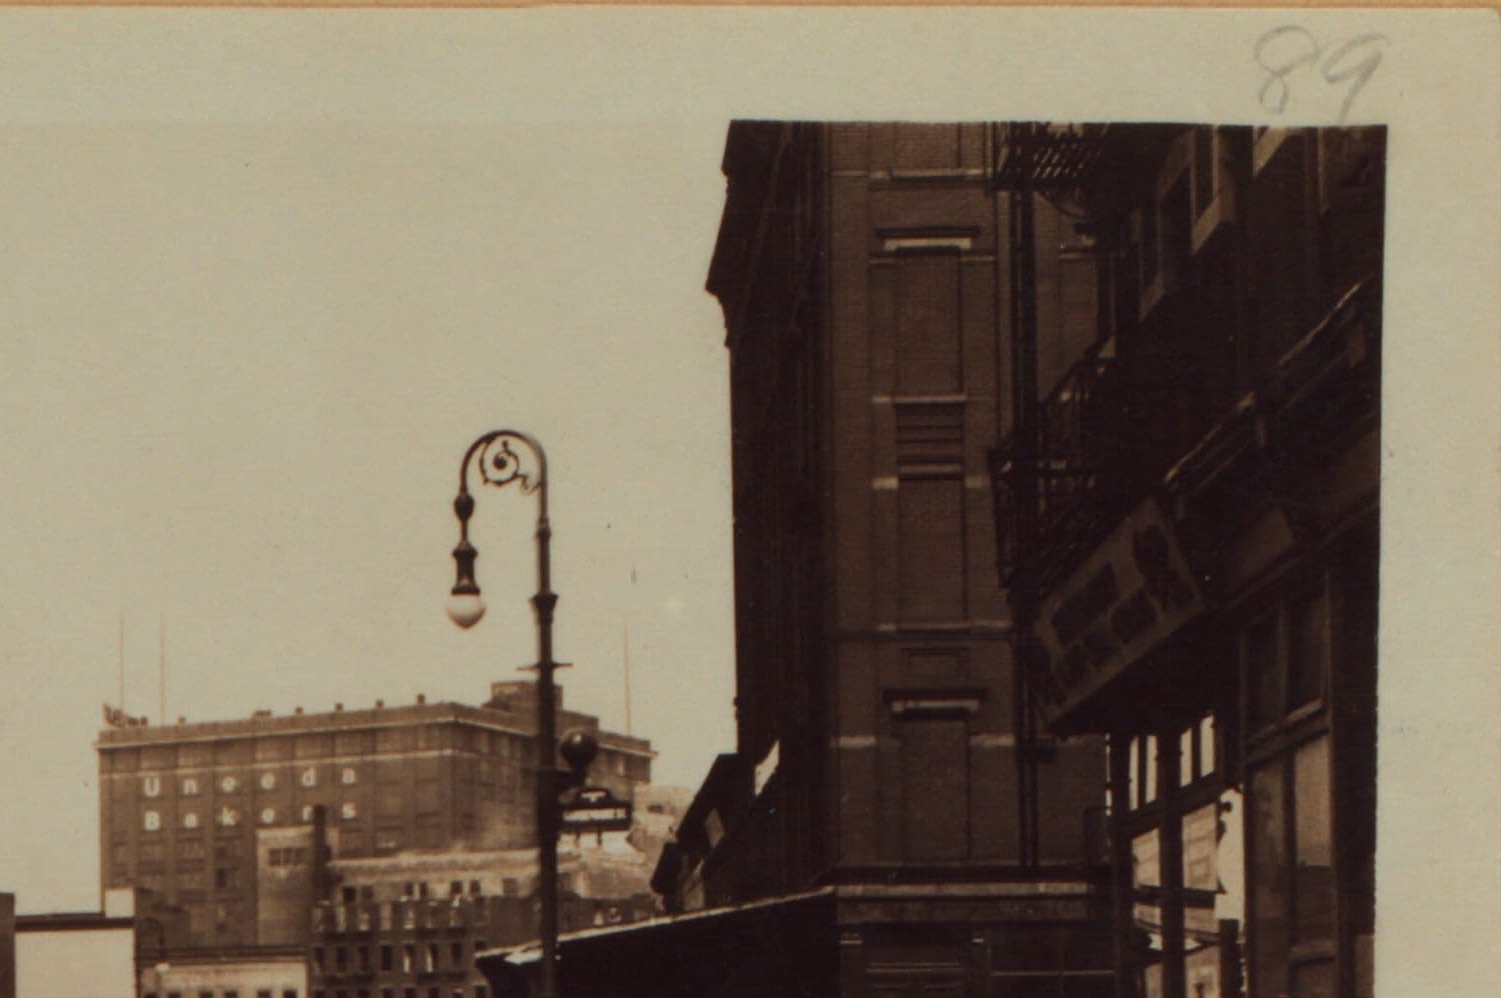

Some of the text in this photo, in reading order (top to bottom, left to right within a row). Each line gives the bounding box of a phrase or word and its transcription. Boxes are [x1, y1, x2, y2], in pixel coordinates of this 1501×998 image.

[1254, 24, 1389, 126] 89
[143, 767, 356, 797] Uneeda
[143, 803, 356, 831] Bakers
